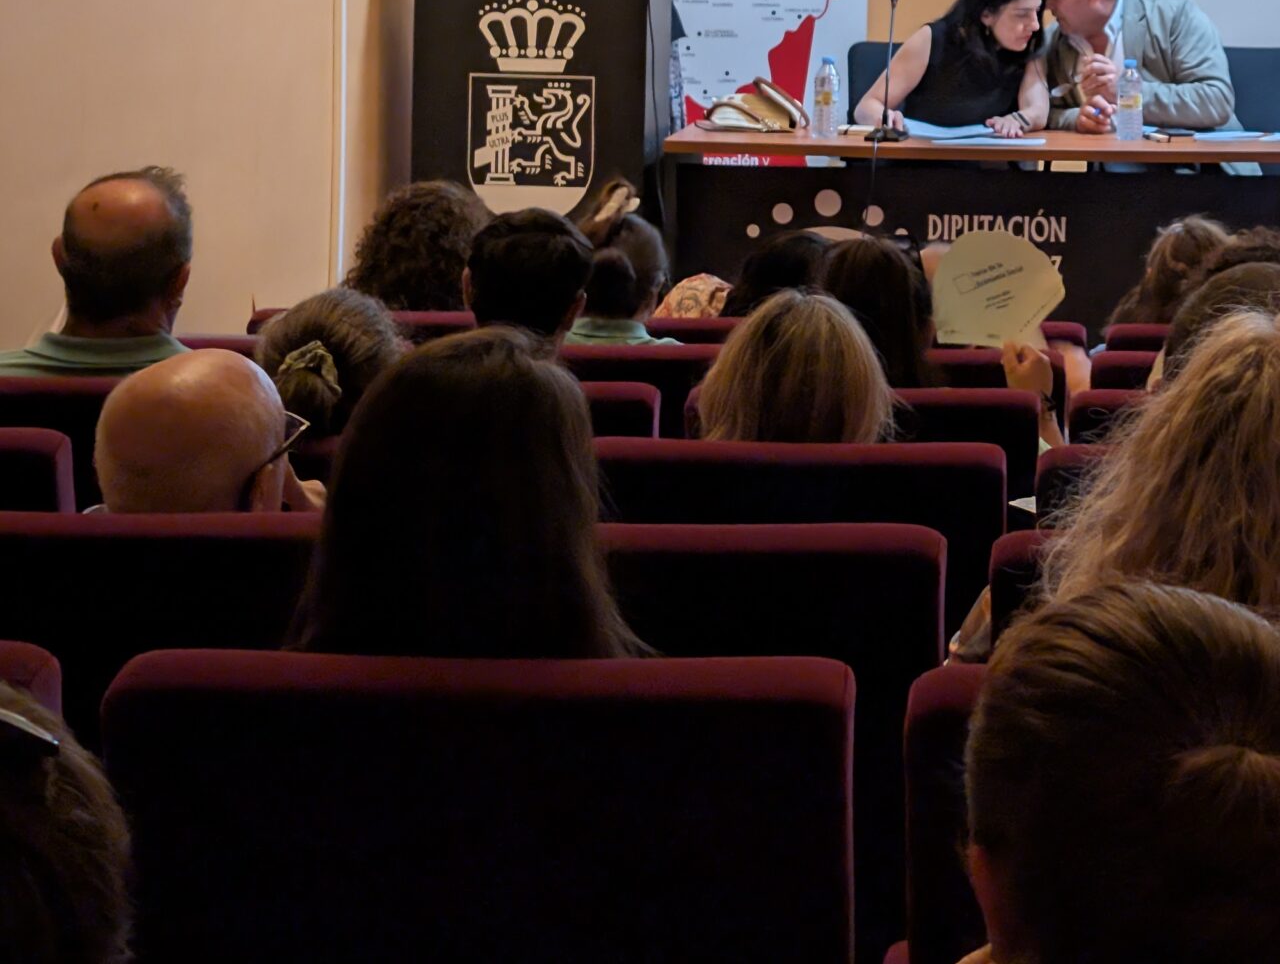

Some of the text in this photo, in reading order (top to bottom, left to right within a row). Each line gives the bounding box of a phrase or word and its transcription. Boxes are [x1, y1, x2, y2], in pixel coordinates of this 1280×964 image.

[490, 112, 509, 124] PLUS
[488, 136, 510, 148] ULTRA
[927, 208, 1067, 243] DIPUTACIÓN
